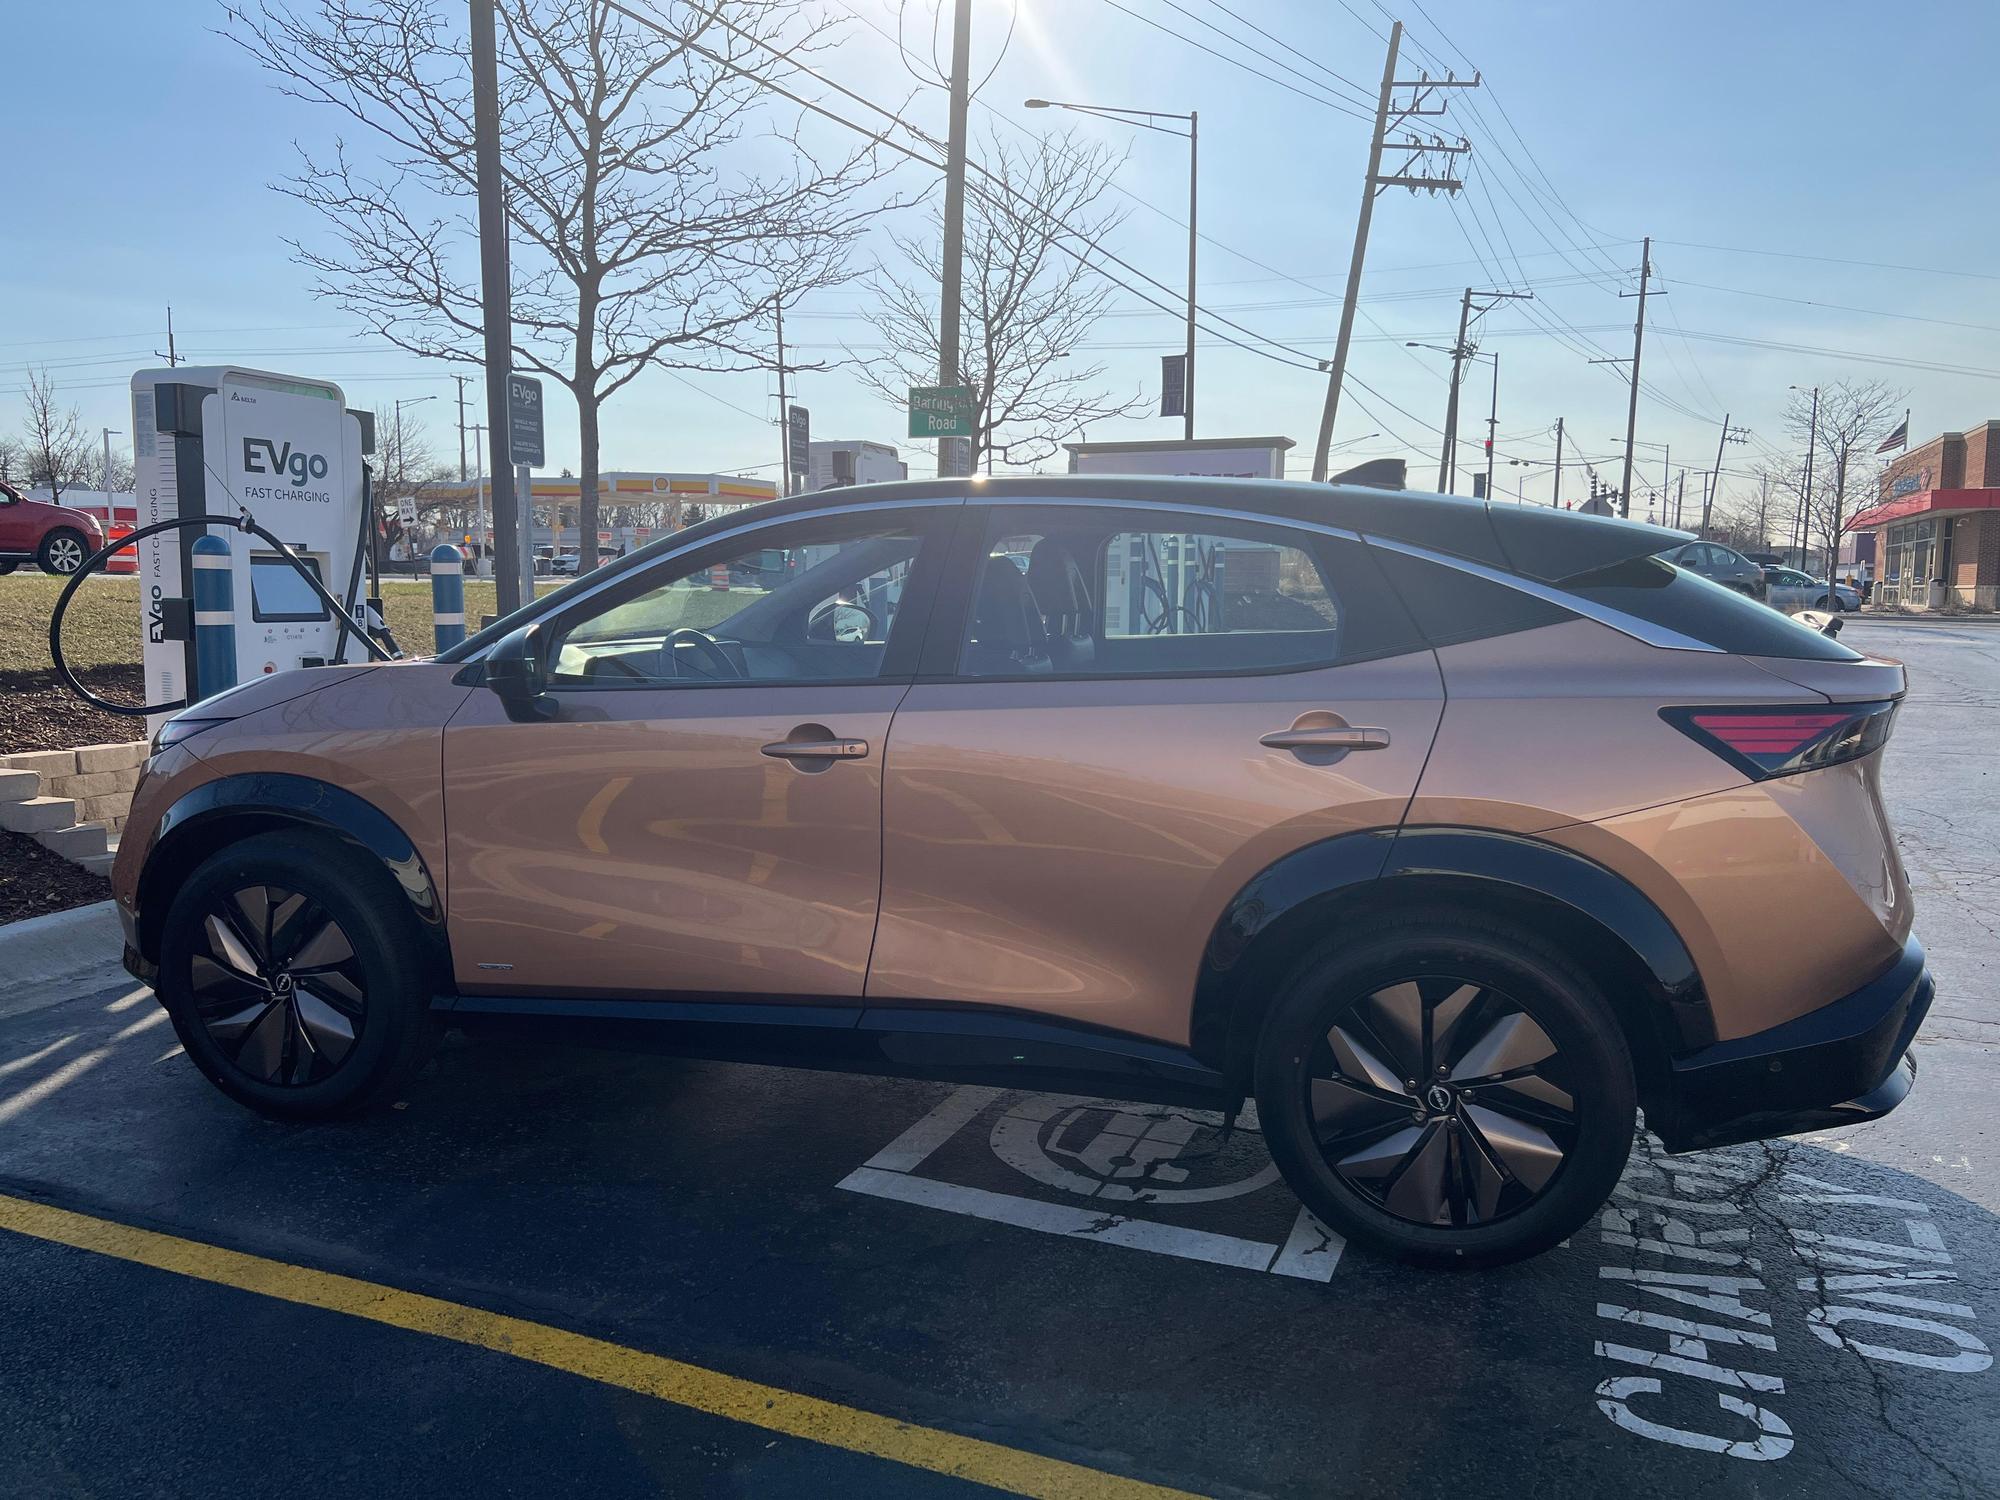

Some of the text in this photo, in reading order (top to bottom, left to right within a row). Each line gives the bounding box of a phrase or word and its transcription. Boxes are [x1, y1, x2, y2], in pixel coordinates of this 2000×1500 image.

[512, 383, 537, 405] EVgo
[928, 416, 957, 430] Road
[243, 437, 328, 487] EVgo
[245, 487, 330, 503] FAST CHARGING
[401, 499, 413, 507] ONE
[150, 488, 160, 549] CHRGING
[1780, 1171, 1994, 1373] ONLY
